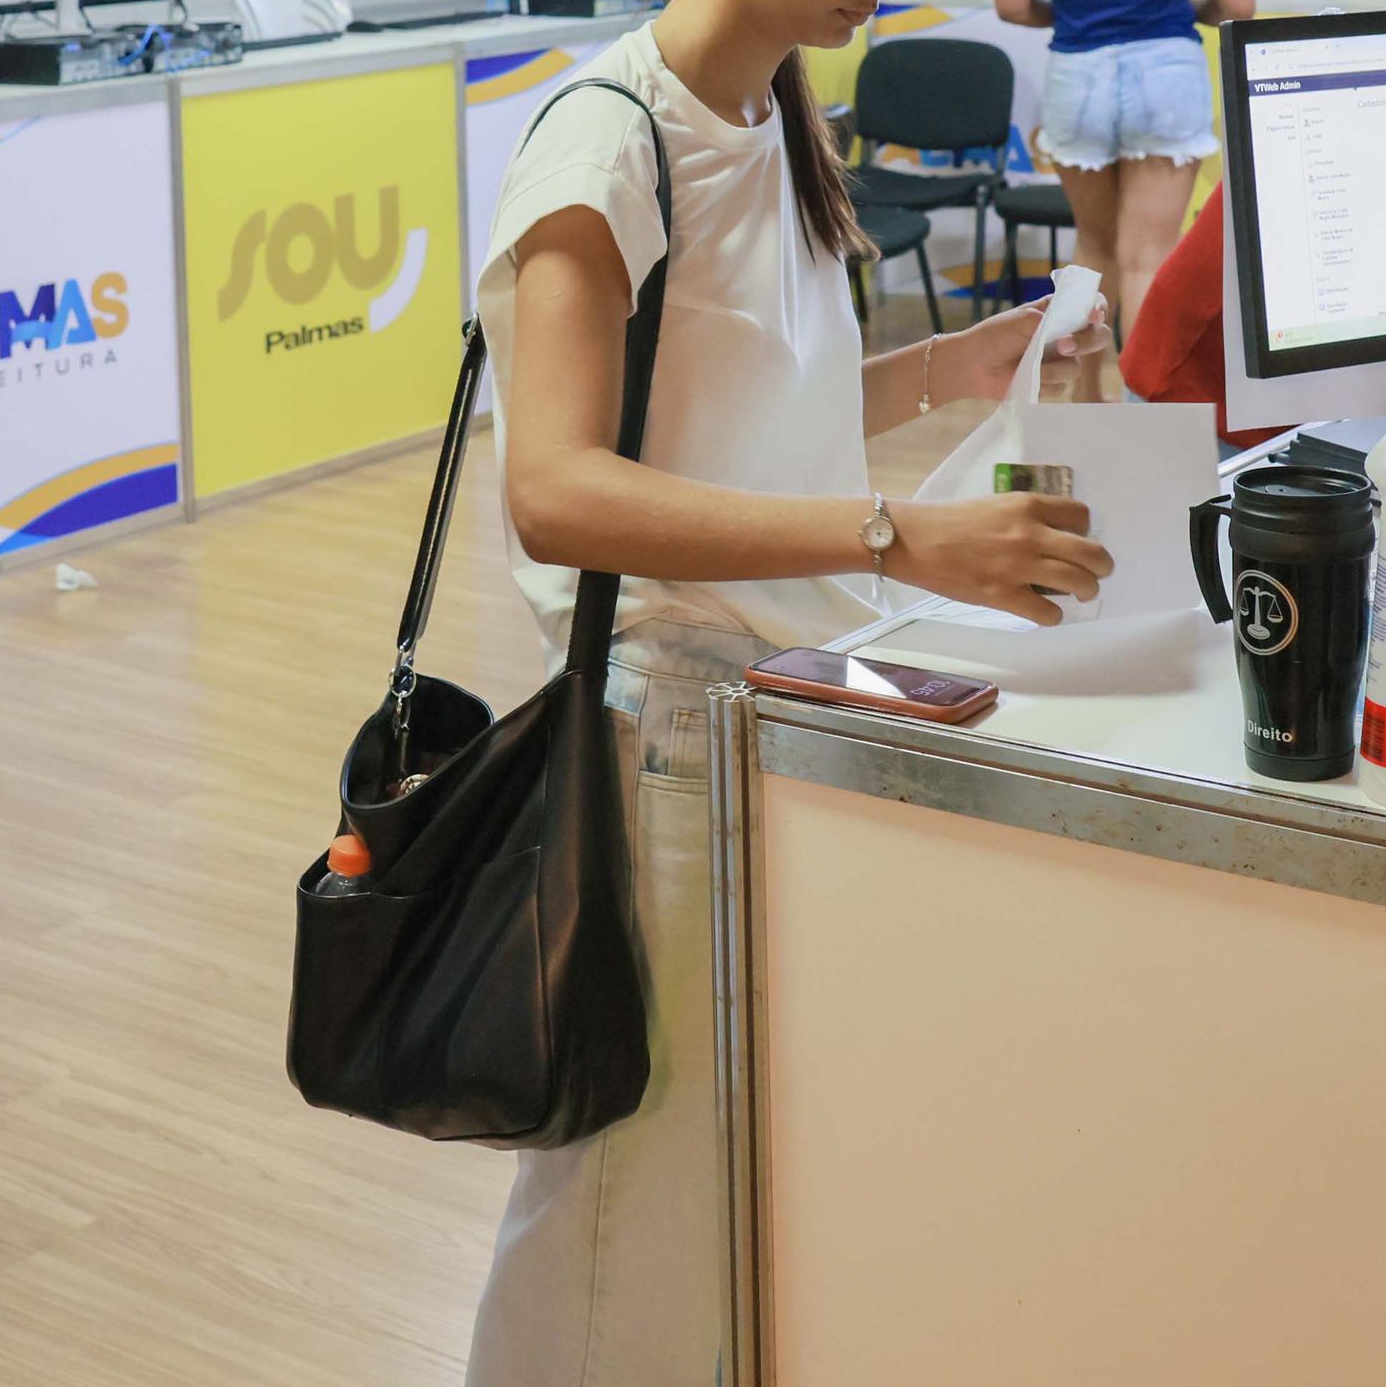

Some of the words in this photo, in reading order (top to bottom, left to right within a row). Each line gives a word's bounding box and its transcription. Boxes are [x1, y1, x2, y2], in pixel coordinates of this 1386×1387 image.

[1254, 83, 1279, 92] VTWeb
[1280, 81, 1301, 91] Admin
[216, 185, 401, 324] SOU
[265, 316, 365, 354] Palmas
[1246, 720, 1293, 743] Direito
